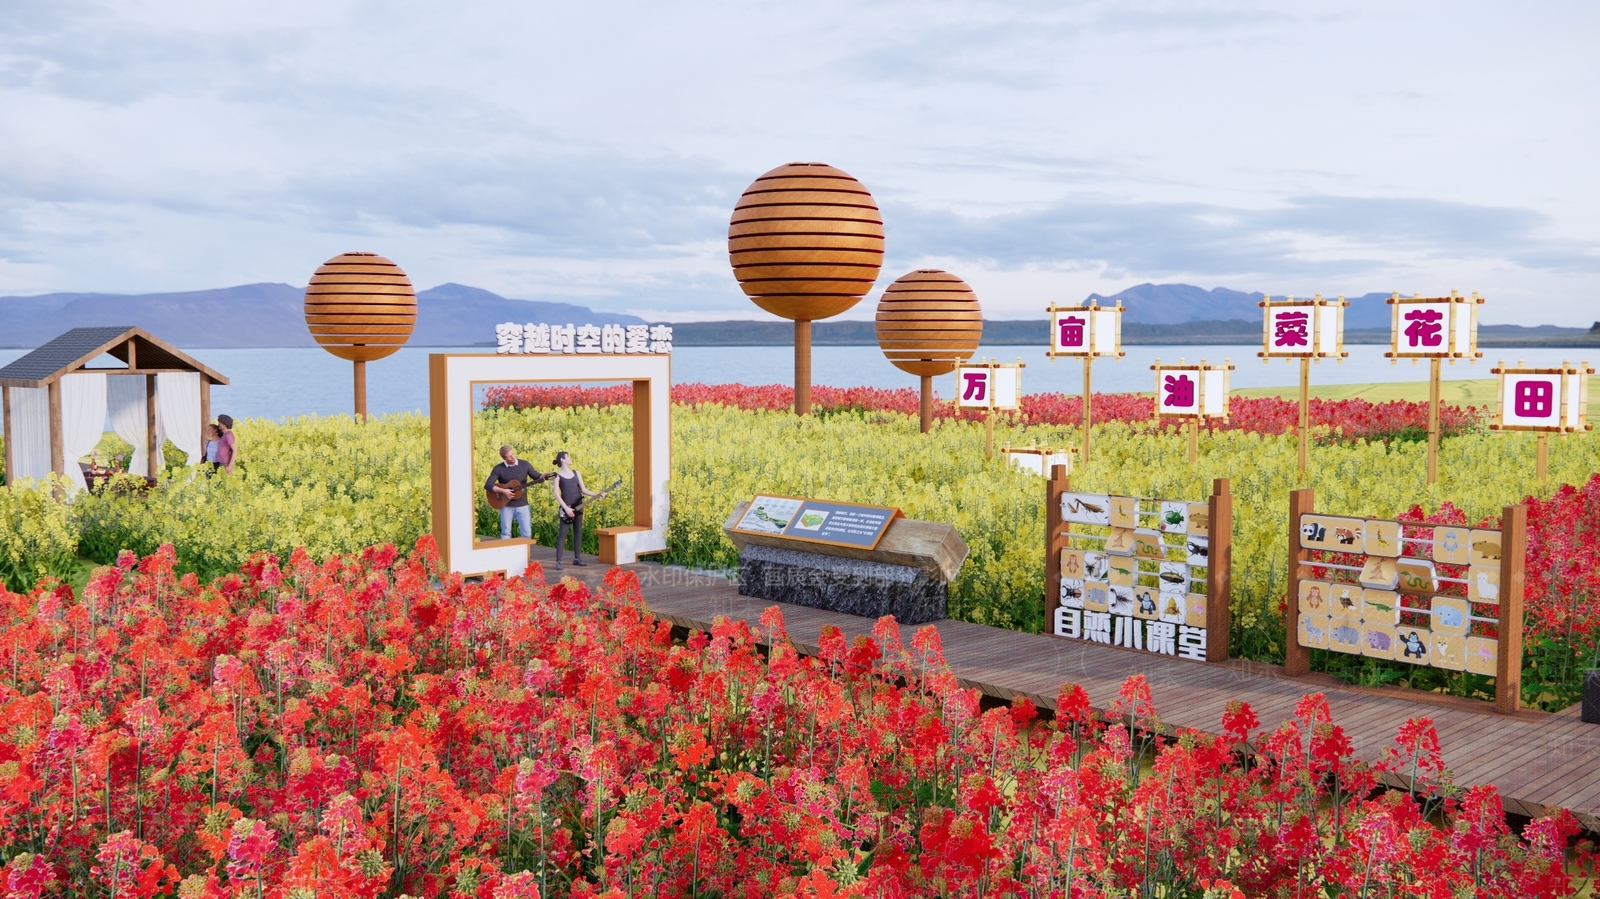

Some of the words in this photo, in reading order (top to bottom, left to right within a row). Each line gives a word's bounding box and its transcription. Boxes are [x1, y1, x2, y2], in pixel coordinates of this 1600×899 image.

[495, 321, 673, 354] 穿越时空的爱恋
[1058, 315, 1086, 347] 亩
[1274, 311, 1309, 348] 菜
[1404, 309, 1444, 348] 花
[962, 372, 988, 402] 万
[1163, 374, 1195, 408] 油
[1514, 380, 1553, 419] 田
[1053, 606, 1207, 662] 自然小课堂
